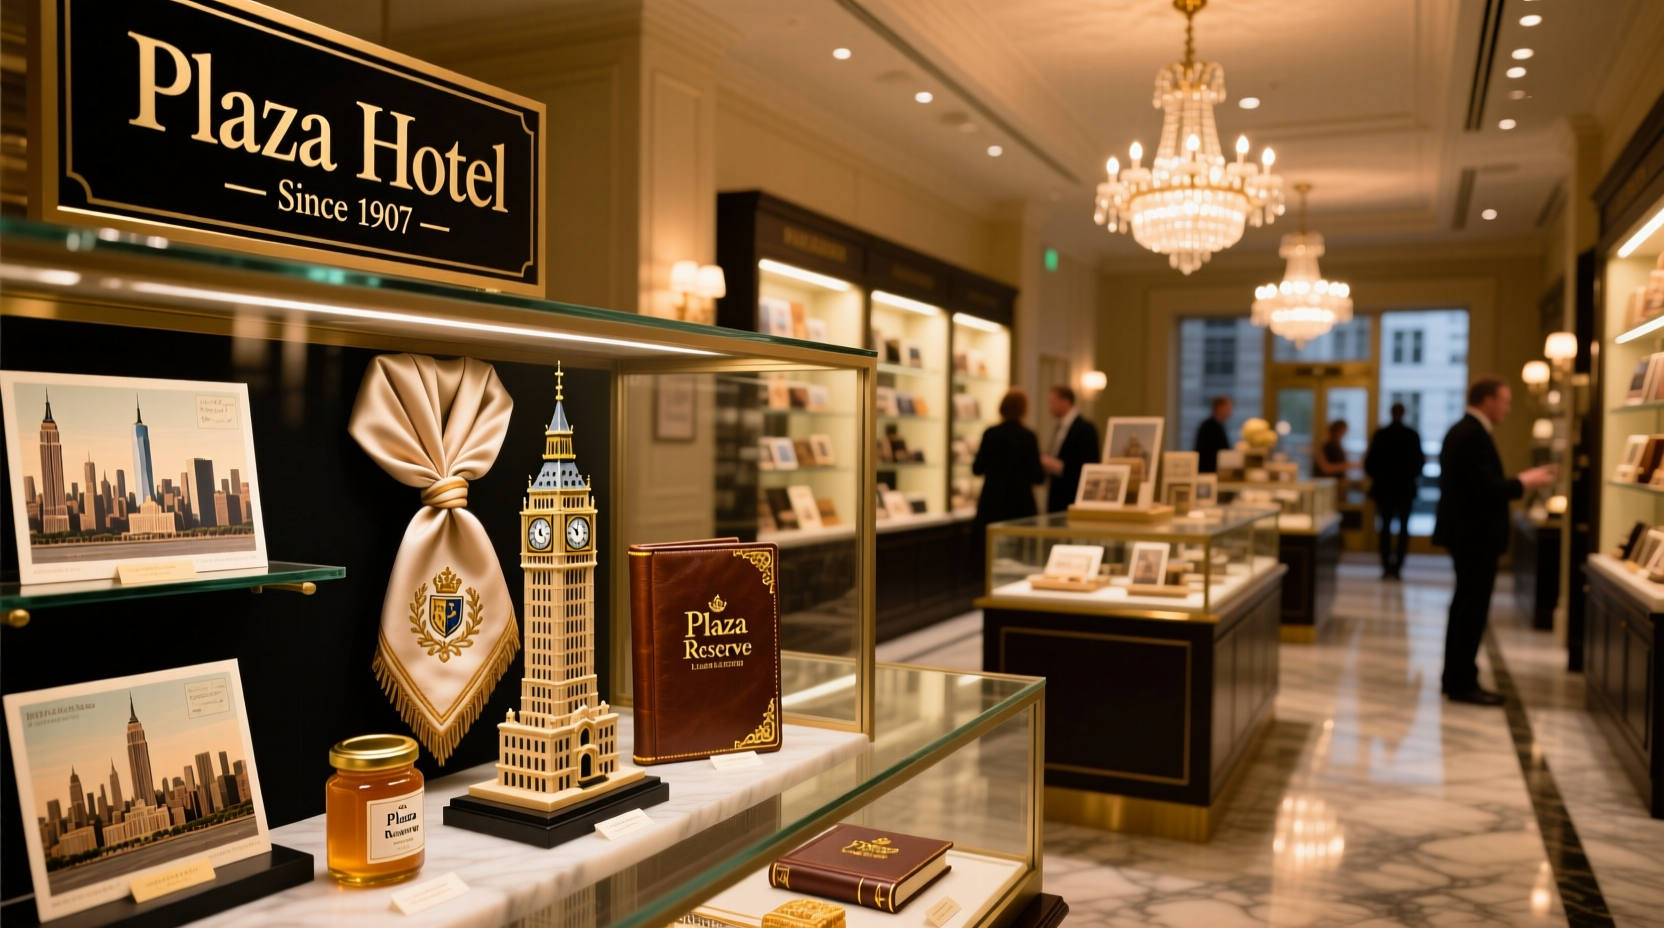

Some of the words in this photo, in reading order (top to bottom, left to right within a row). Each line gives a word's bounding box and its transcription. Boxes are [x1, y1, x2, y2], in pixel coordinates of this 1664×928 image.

[127, 30, 338, 172] Plaza
[355, 100, 510, 213] Hotel
[278, 179, 348, 222] Since
[357, 198, 413, 235] 1907
[684, 610, 749, 638] Plaza
